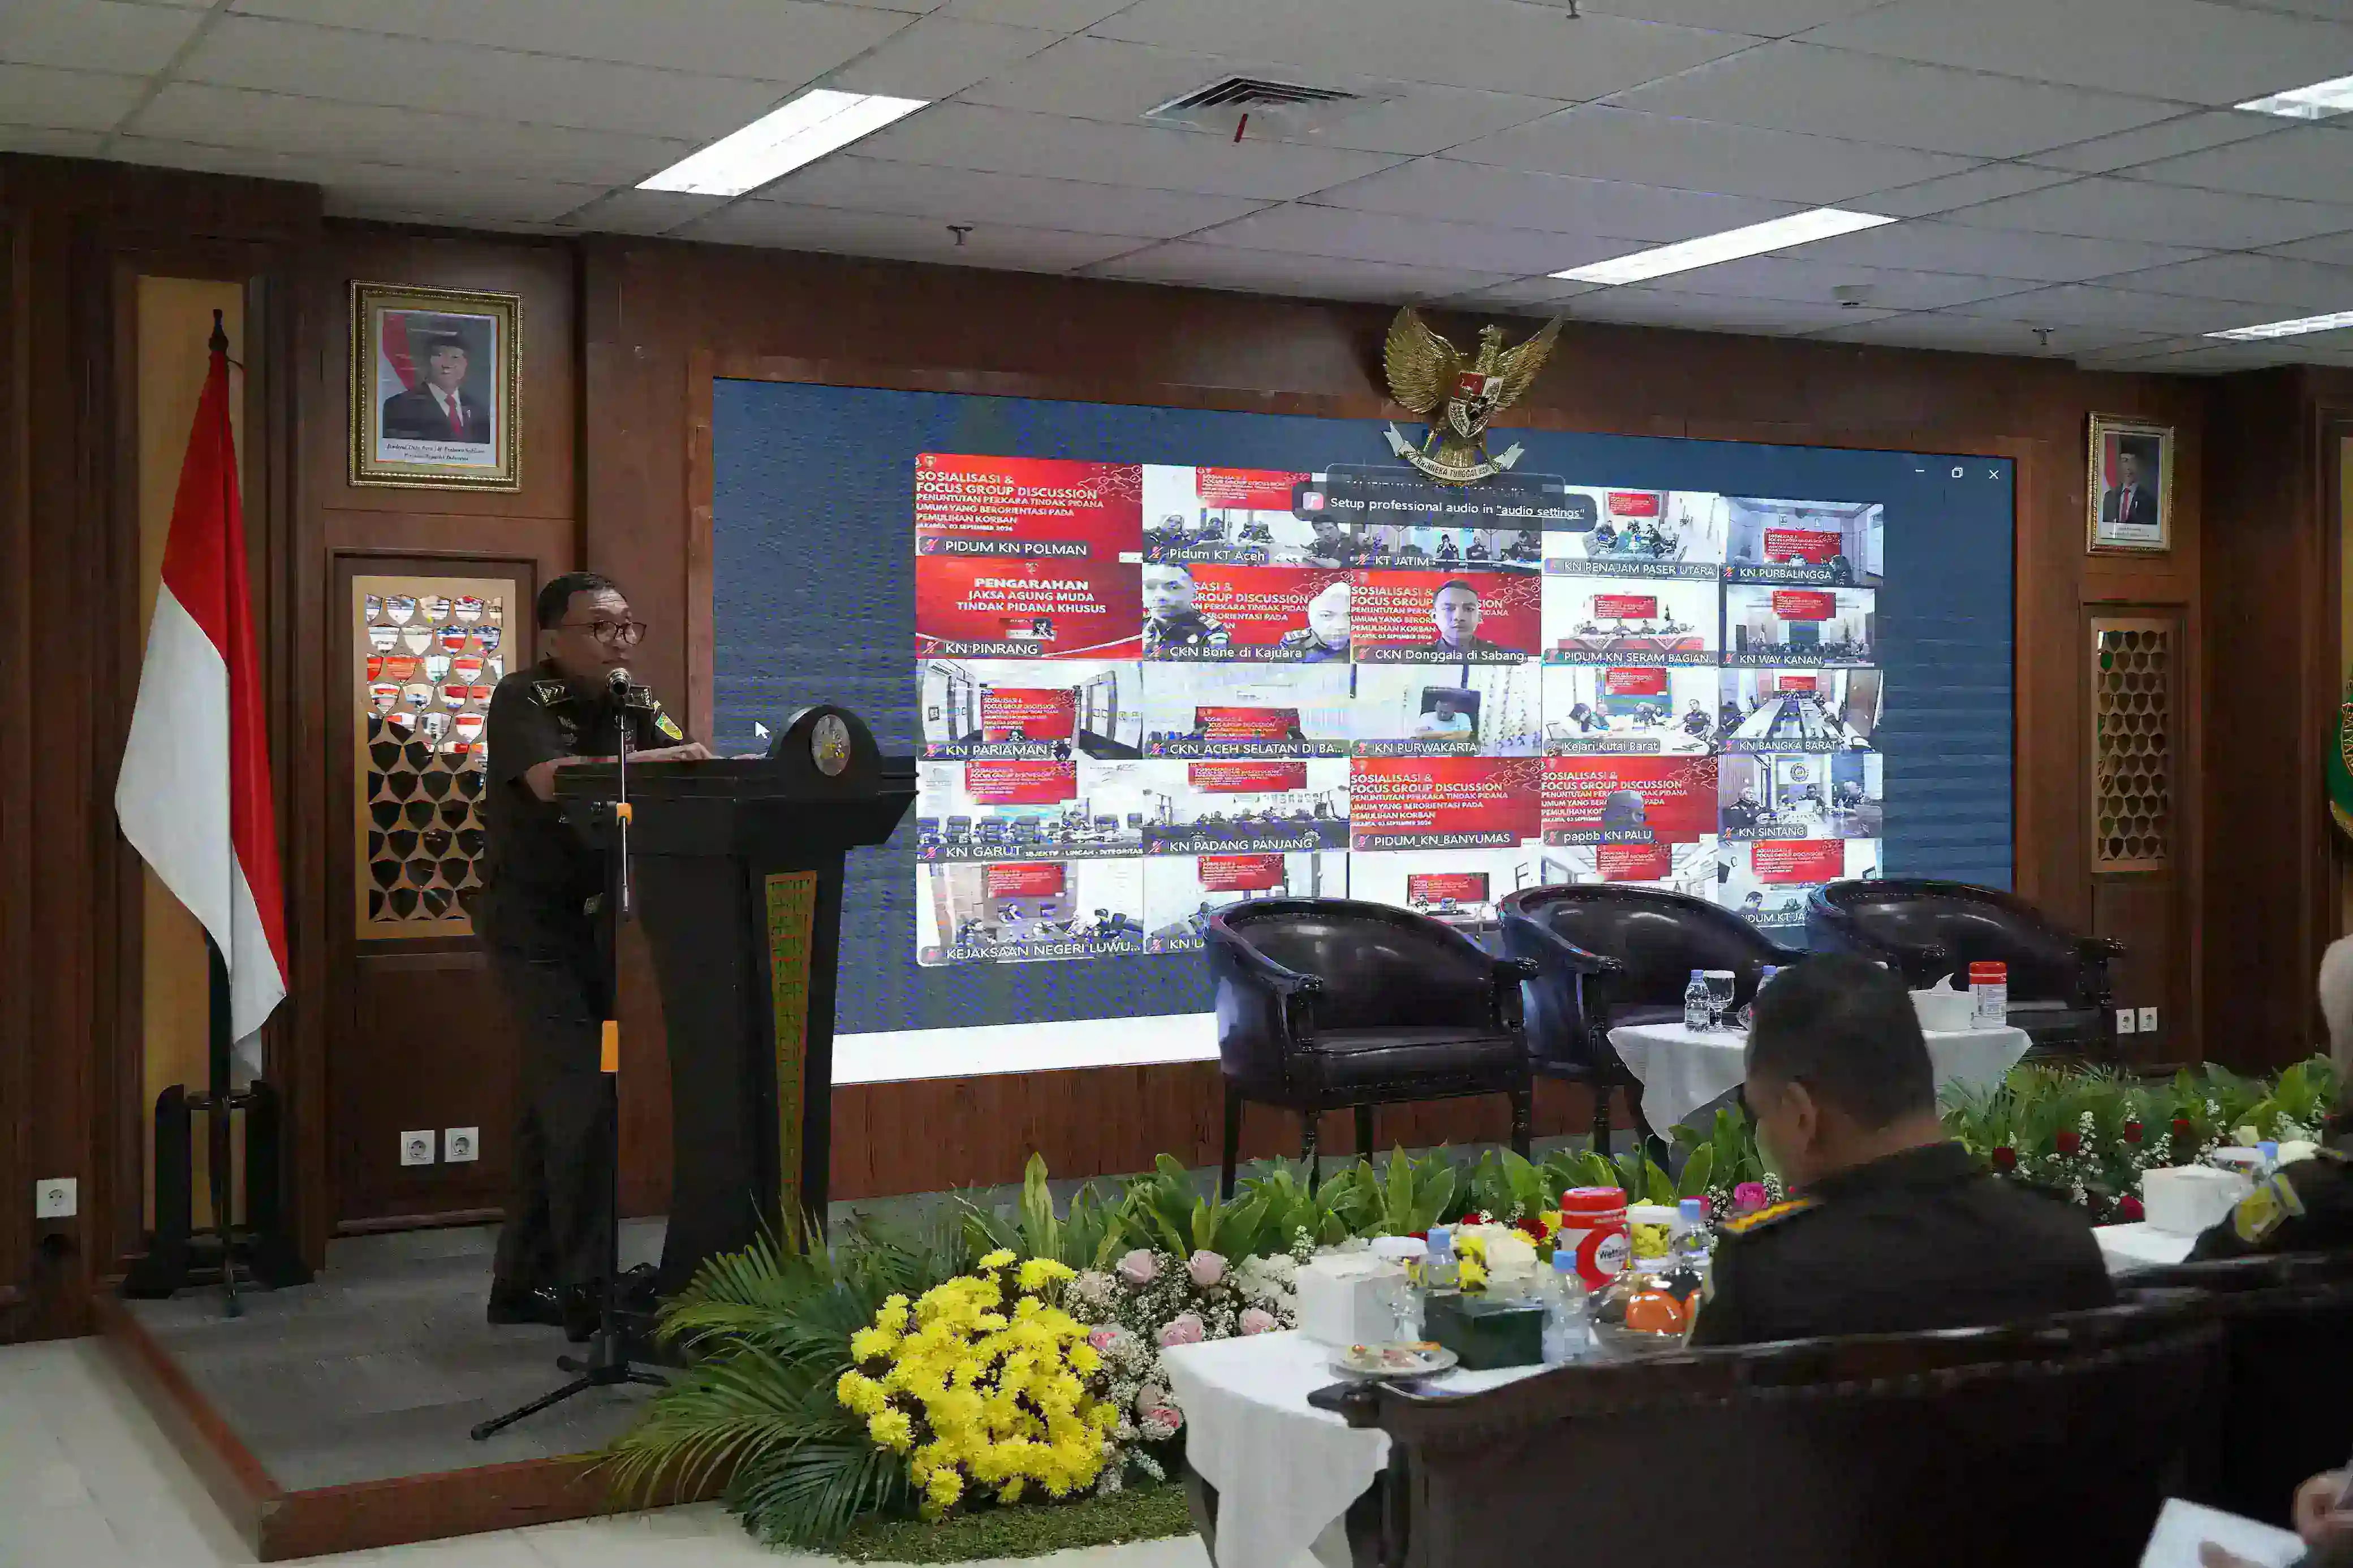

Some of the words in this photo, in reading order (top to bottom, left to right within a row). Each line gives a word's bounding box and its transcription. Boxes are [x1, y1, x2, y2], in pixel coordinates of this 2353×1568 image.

[1416, 458, 1447, 475] BHINNEKA
[916, 471, 1000, 484] SOSIALISASI
[1005, 476, 1014, 485] &
[916, 482, 962, 493] FOCUS
[966, 484, 1014, 496] GROUP
[1018, 487, 1097, 499] DISCUSSION
[916, 494, 982, 503] PENUNTUTAN
[1330, 498, 1364, 510] Setup
[1369, 502, 1442, 511] professional
[1447, 504, 1478, 513] audio
[1483, 505, 1493, 513] in
[945, 541, 993, 552] PIDUM
[998, 542, 1019, 554] KN
[1025, 543, 1087, 556] POLMAN
[1170, 548, 1209, 559] Pidum
[1214, 550, 1230, 560] KT
[1235, 551, 1265, 561] Aceh
[1375, 556, 1391, 566] KT
[1395, 556, 1429, 566] JATIM
[1565, 561, 1581, 571] KN
[1585, 562, 1639, 573] PENAJAM
[1643, 565, 1677, 574] PASER
[1679, 566, 1714, 576] UTARA
[1740, 568, 1756, 577] KN
[1759, 569, 1831, 580] PURBALINGGA
[975, 578, 1088, 590] PENGARAHAN
[968, 590, 1005, 601] JAKSA
[1008, 591, 1053, 601] AGUNG
[1057, 593, 1094, 602] MUDA
[1351, 586, 1422, 595] SOSIALISASI
[1236, 593, 1309, 603] DISCUSSION
[1351, 597, 1389, 605] FOCUS
[1393, 597, 1433, 606] GROUP
[956, 602, 1004, 611] TINDAK
[1007, 603, 1054, 612] PIDANA
[1058, 604, 1106, 614] KHUSUS
[945, 642, 967, 654] KN
[973, 643, 1038, 655] PINRANG
[1170, 646, 1198, 657] CKN
[1203, 647, 1234, 657] Bone
[1239, 647, 1251, 657] di
[1255, 647, 1302, 659] Kajuara
[1376, 650, 1401, 659] CKN
[1406, 650, 1463, 661] Donggala
[1467, 650, 1477, 660] di
[1481, 650, 1524, 662] Sabang
[1564, 652, 1601, 662] PIDUM
[1606, 652, 1622, 662] KN
[1627, 652, 1665, 662] SERAM
[1740, 655, 1755, 664] KN
[1759, 655, 1781, 664] WAY
[1785, 655, 1822, 665] KANAN
[946, 745, 967, 755] KN
[973, 745, 1047, 755] PARIAMAN
[1170, 744, 1198, 754] CKN
[1204, 744, 1239, 754] ACEH
[1243, 744, 1298, 753] SELATAN
[1303, 744, 1314, 753] DI
[1374, 743, 1393, 753] KN
[1397, 742, 1477, 753] PURWAKARTA
[1564, 741, 1595, 752] Kejari
[1598, 741, 1629, 751] Kutai
[1630, 741, 1658, 751] Barat
[1739, 741, 1754, 750] KN
[1759, 741, 1802, 750] BANGKA
[1805, 741, 1837, 750] BARAT
[1351, 774, 1419, 783] SOSIALISASI
[1609, 771, 1617, 780] &
[1351, 784, 1390, 793] FOCUS
[1392, 784, 1432, 792] GROUP
[1436, 783, 1502, 792] DISCUSSION
[1542, 781, 1578, 790] FOCUS
[1621, 780, 1682, 789] DISCUSSION
[1564, 832, 1600, 843] papbb
[1604, 832, 1621, 840] KN
[1624, 831, 1651, 840] PALU
[1739, 828, 1755, 837] KN
[1759, 828, 1804, 837] SINTANG
[1374, 833, 1510, 846] PIDUM_KN_BANYUMAS
[946, 846, 967, 857] KN
[973, 845, 1022, 857] GARUT
[1170, 841, 1190, 852] KN
[1195, 840, 1248, 850] PADANG
[1253, 839, 1312, 849] PANJANG
[1777, 913, 1790, 922] KT
[1170, 939, 1189, 949] KN
[946, 947, 1028, 960] KEJAKSAAN
[1034, 944, 1085, 956] NEGERI
